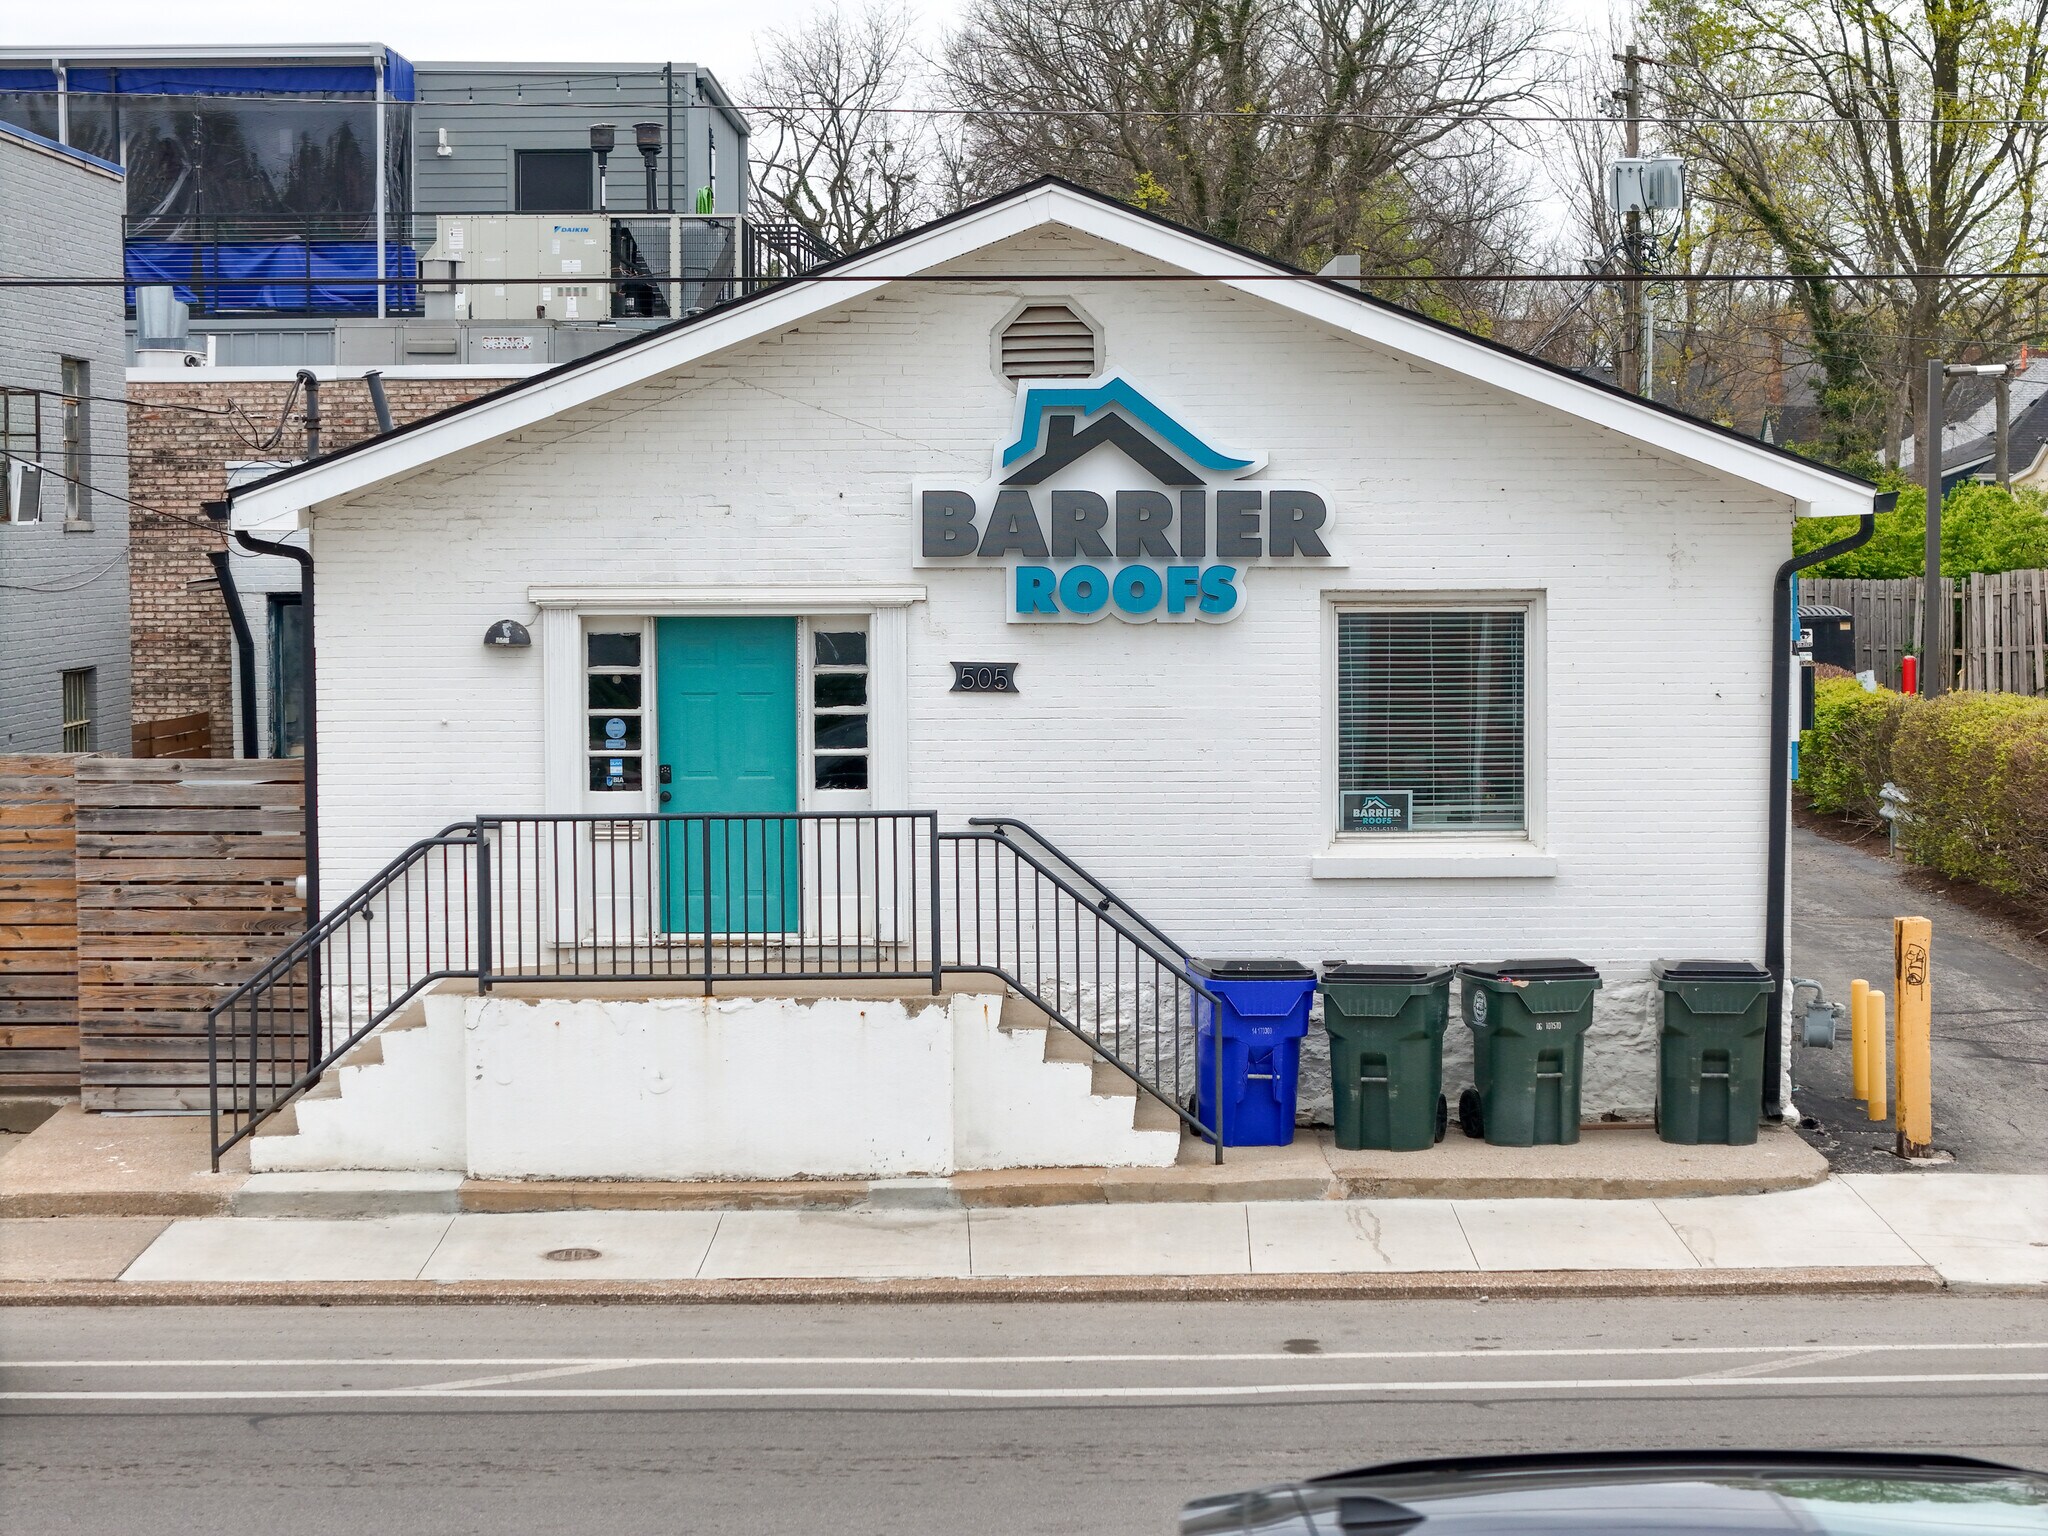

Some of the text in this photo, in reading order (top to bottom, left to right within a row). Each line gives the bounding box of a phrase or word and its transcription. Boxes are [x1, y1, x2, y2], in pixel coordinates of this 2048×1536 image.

[922, 490, 1331, 557] BARRIER
[1016, 564, 1238, 615] ROOFS
[961, 667, 1008, 690] 505
[1353, 808, 1401, 817] BARRIER
